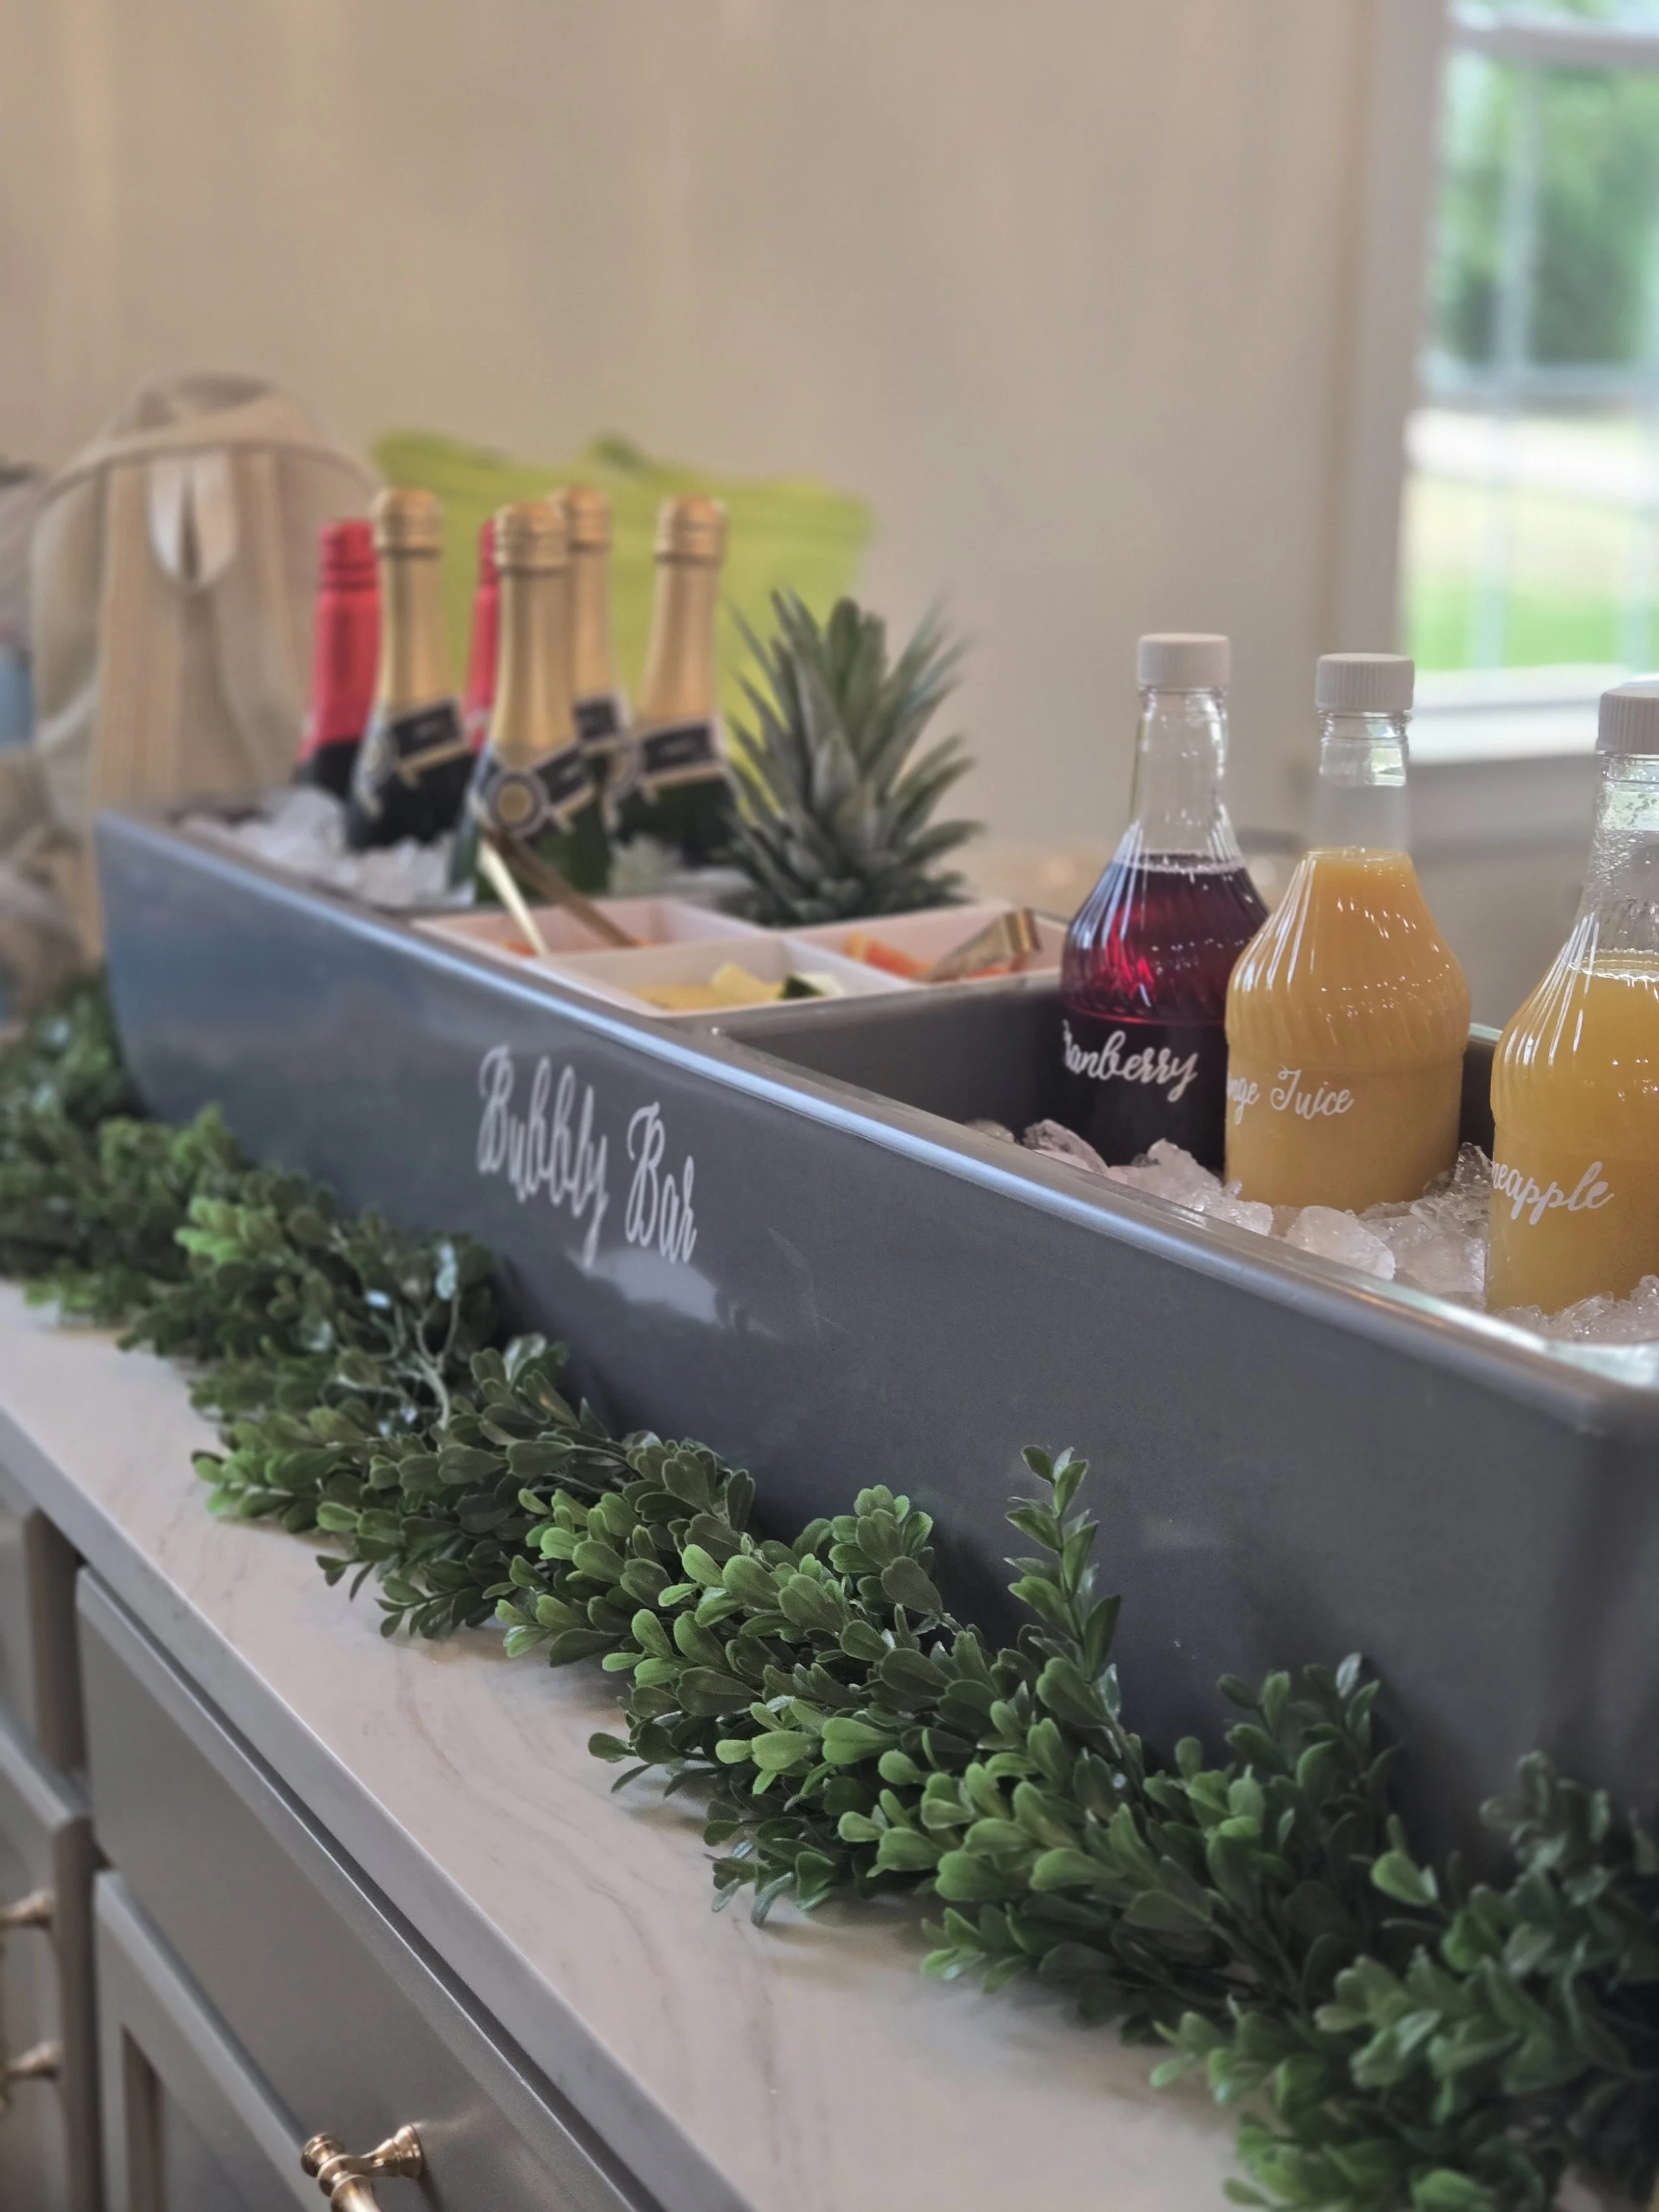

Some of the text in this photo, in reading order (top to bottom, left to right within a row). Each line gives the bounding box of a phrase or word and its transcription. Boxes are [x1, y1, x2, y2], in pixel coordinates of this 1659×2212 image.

[1062, 1019, 1198, 1102] ranberry
[1270, 1064, 1354, 1120] Juice
[476, 1045, 697, 1270] Bubbly Bar
[1492, 1161, 1615, 1225] neapple
